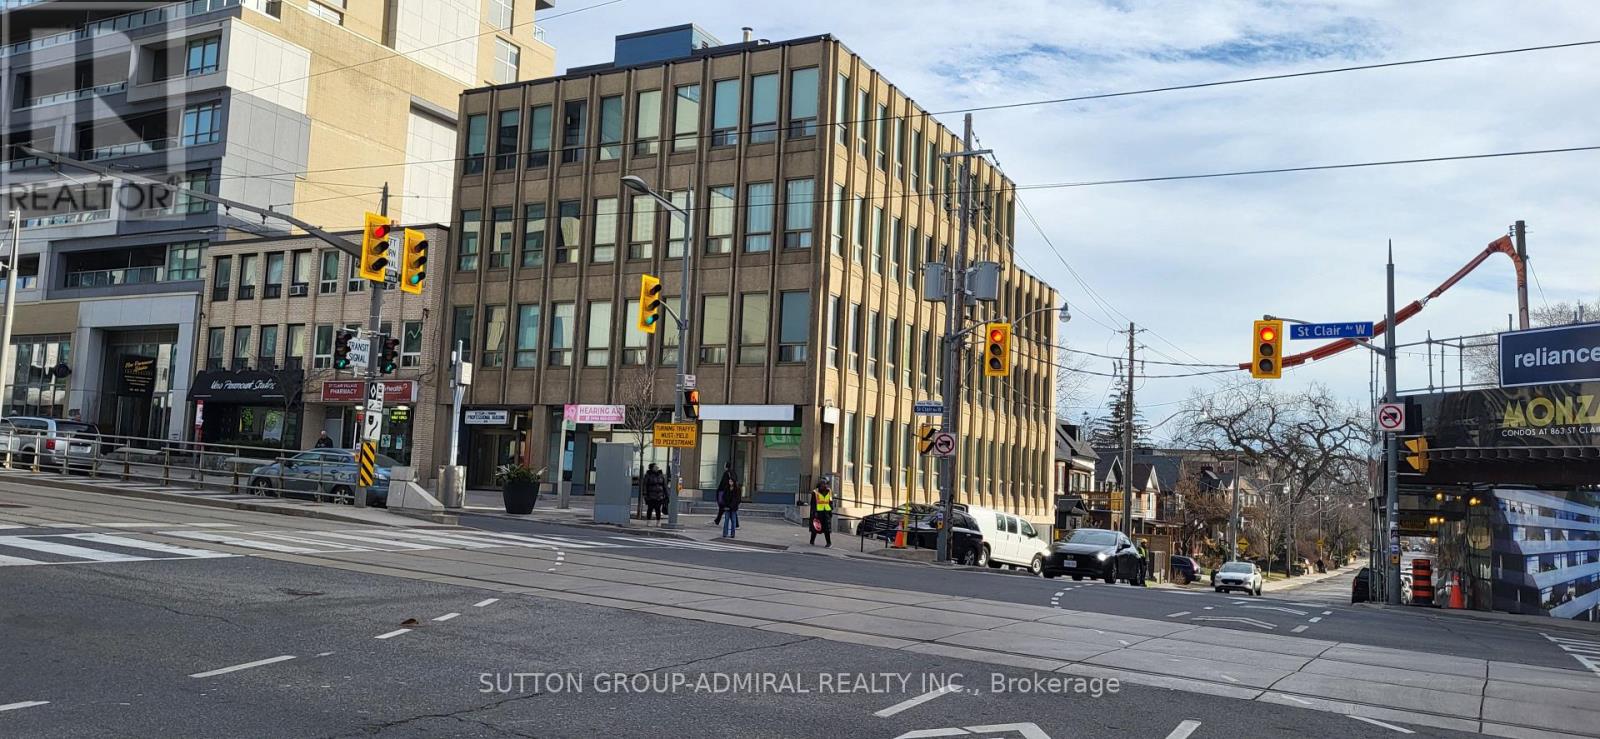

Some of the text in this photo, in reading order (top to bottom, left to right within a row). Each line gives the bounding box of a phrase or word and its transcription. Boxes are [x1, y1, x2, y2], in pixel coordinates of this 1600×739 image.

[1297, 326, 1309, 337] St
[1314, 325, 1341, 336] Clair
[1355, 324, 1366, 335] W
[349, 341, 369, 352] TRANSIT
[348, 353, 367, 363] SIGNAL
[1514, 346, 1600, 368] reliance
[580, 407, 609, 415] HEARING
[1502, 394, 1600, 428] MONZ
[1502, 429, 1535, 437] CONDOS
[1550, 427, 1564, 435] 863
